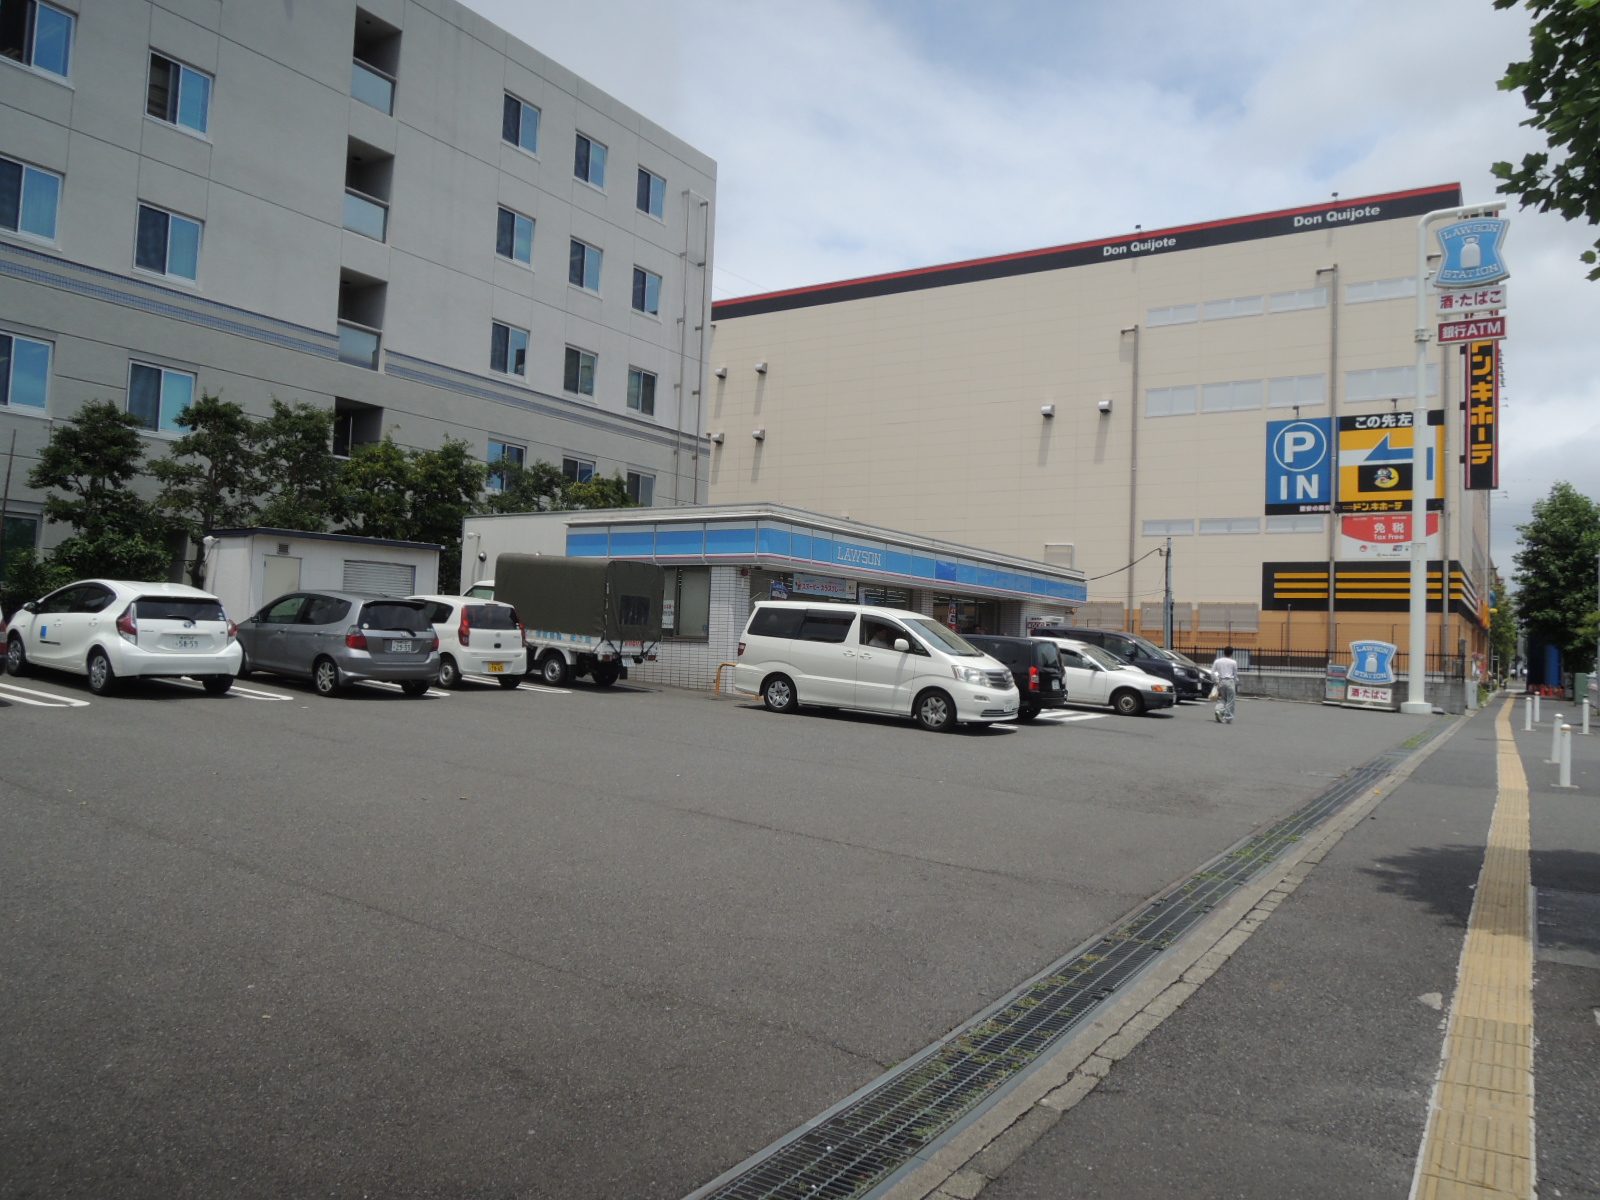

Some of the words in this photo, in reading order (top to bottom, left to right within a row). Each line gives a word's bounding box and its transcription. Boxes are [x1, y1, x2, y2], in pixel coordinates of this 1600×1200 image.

[1293, 211, 1322, 227] Don
[1326, 206, 1380, 221] Quijote
[1443, 224, 1499, 240] LAWSON
[1103, 246, 1127, 256] Don
[1131, 238, 1177, 252] Quijote
[1443, 263, 1499, 279] STATION
[1442, 321, 1501, 338] 銀行ATM
[1355, 413, 1412, 429] この先左
[1284, 431, 1315, 463] P
[1280, 474, 1319, 500] IN
[837, 546, 882, 566] LAWSON
[1355, 645, 1390, 654] LAWSON
[1354, 670, 1387, 679] STATION
